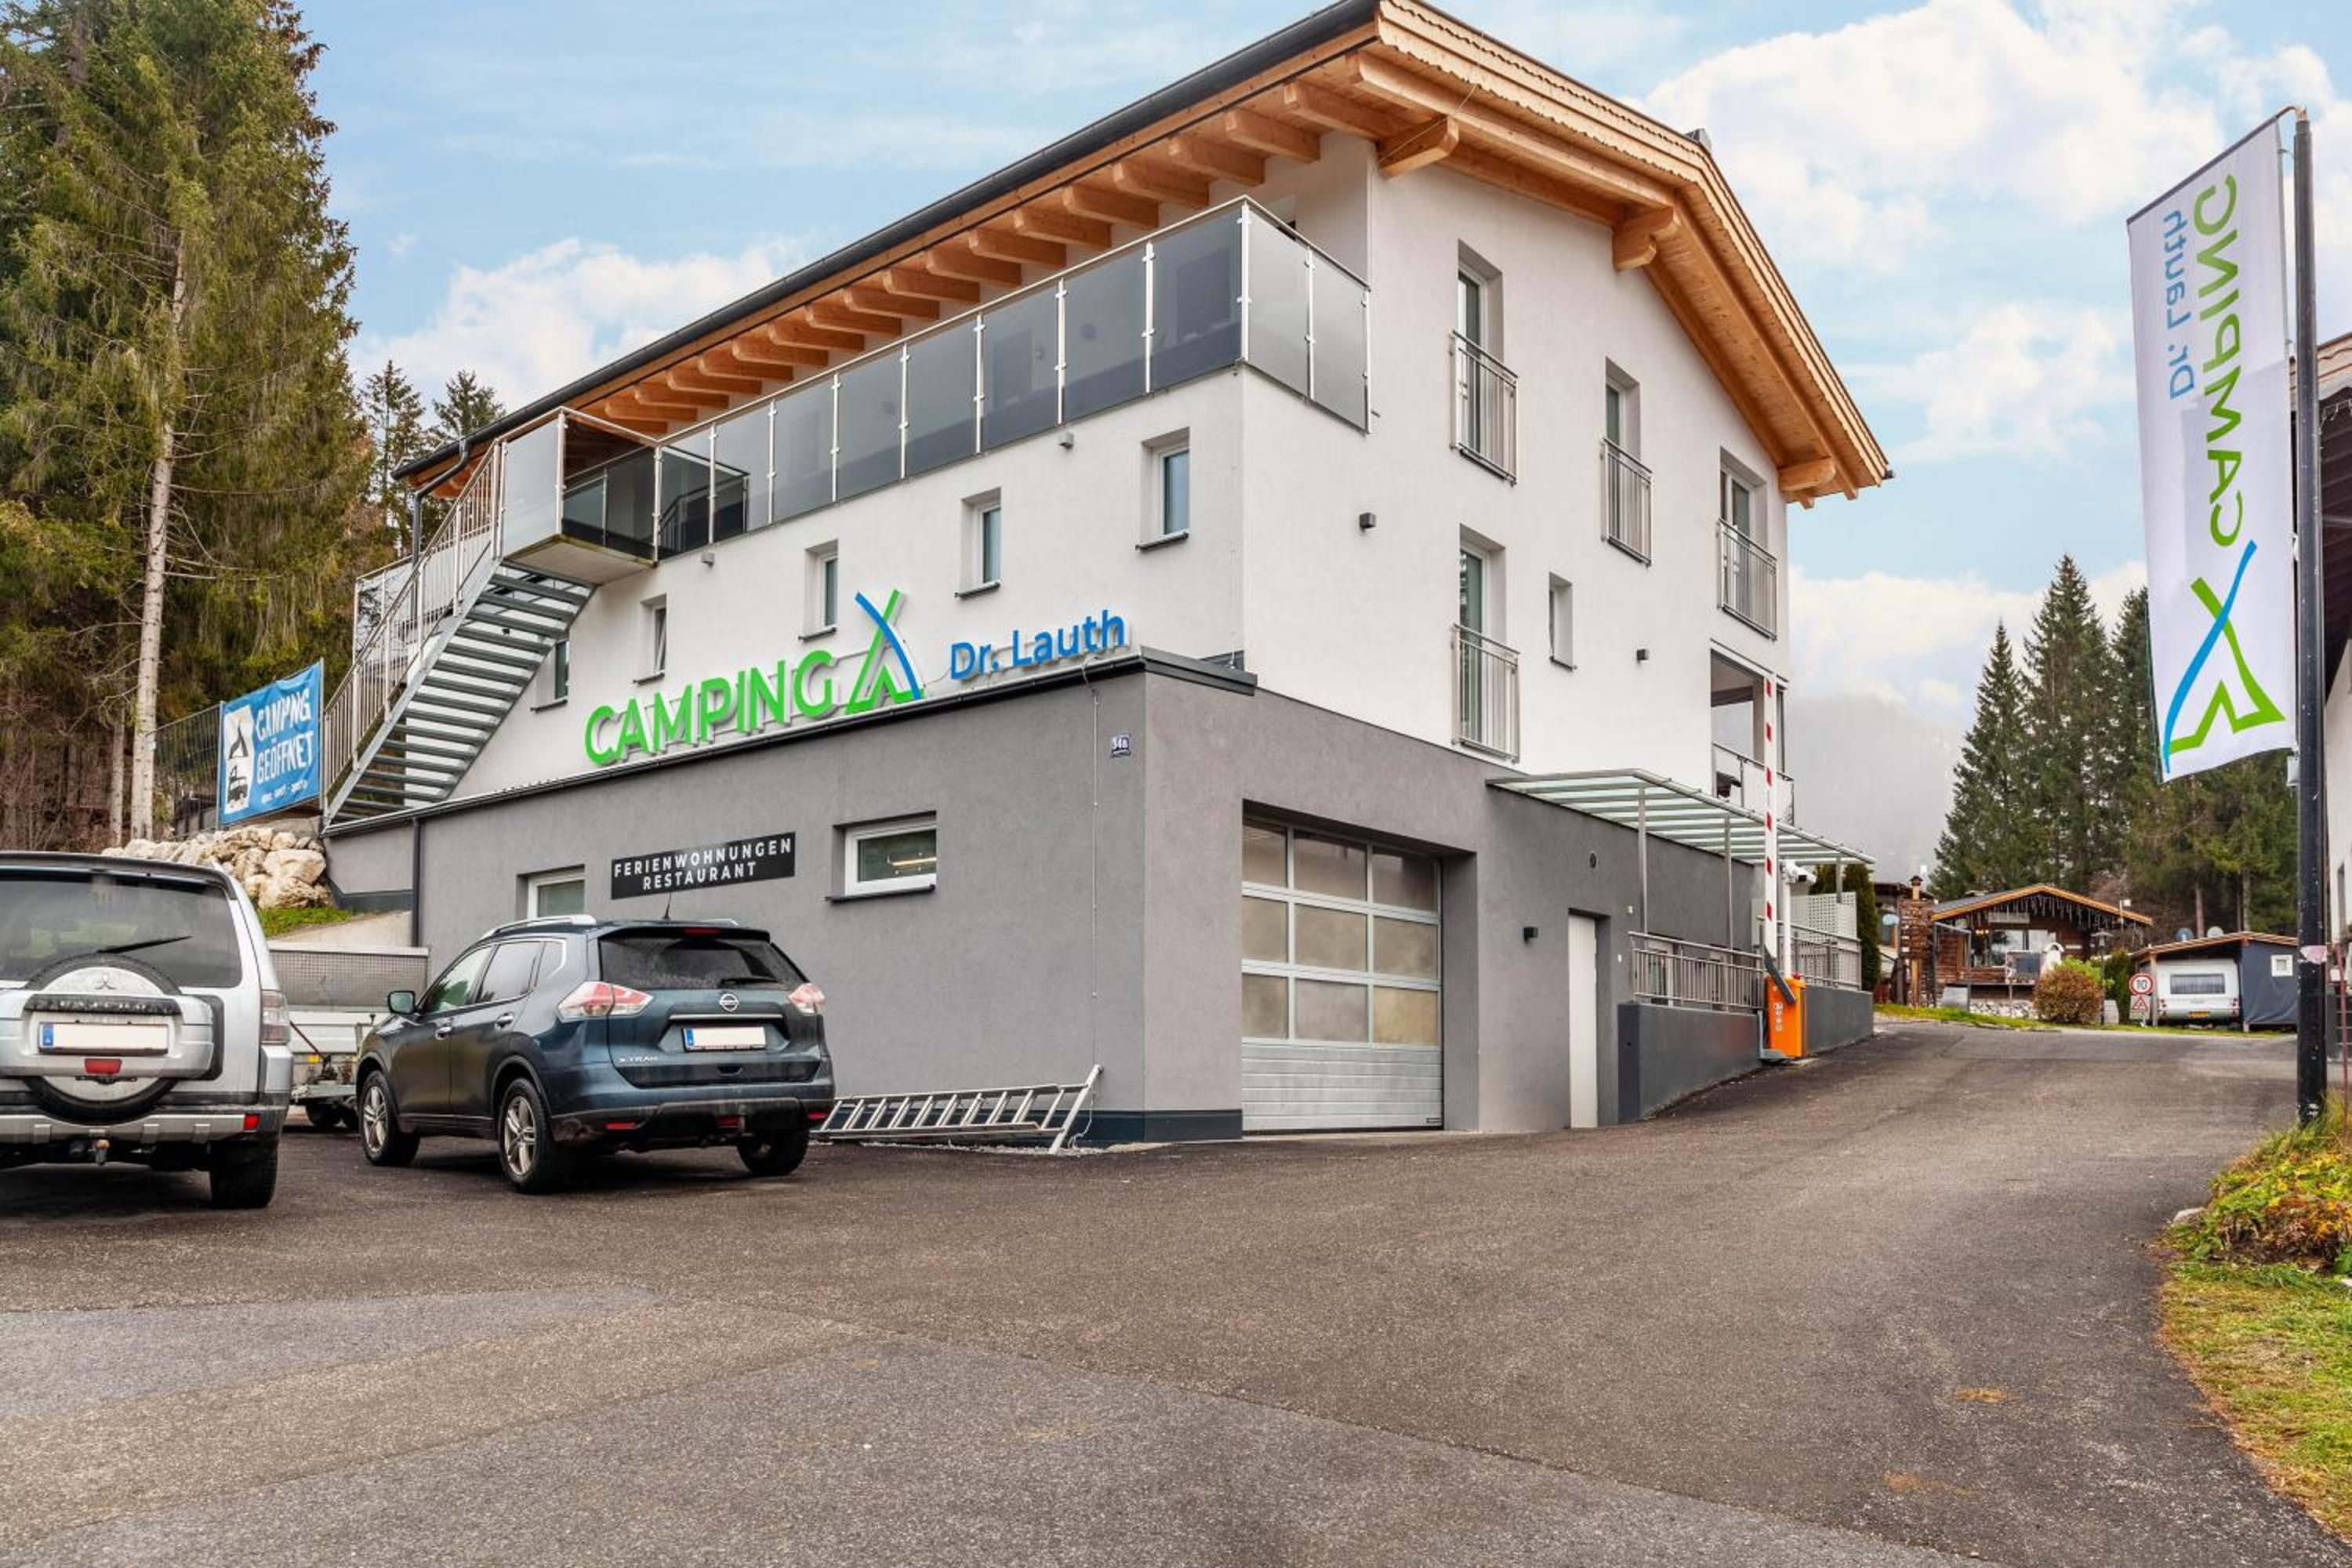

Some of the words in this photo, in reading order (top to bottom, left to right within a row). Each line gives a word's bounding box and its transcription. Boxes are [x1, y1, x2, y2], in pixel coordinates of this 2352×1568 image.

[950, 642, 1000, 681] Dr.
[1013, 609, 1125, 666] Lauth
[584, 649, 833, 766] CAMPING
[256, 731, 314, 784] GEÖFFNET
[614, 838, 791, 877] FERIENWOHNUNGEN
[643, 862, 756, 890] RESTAURANT
